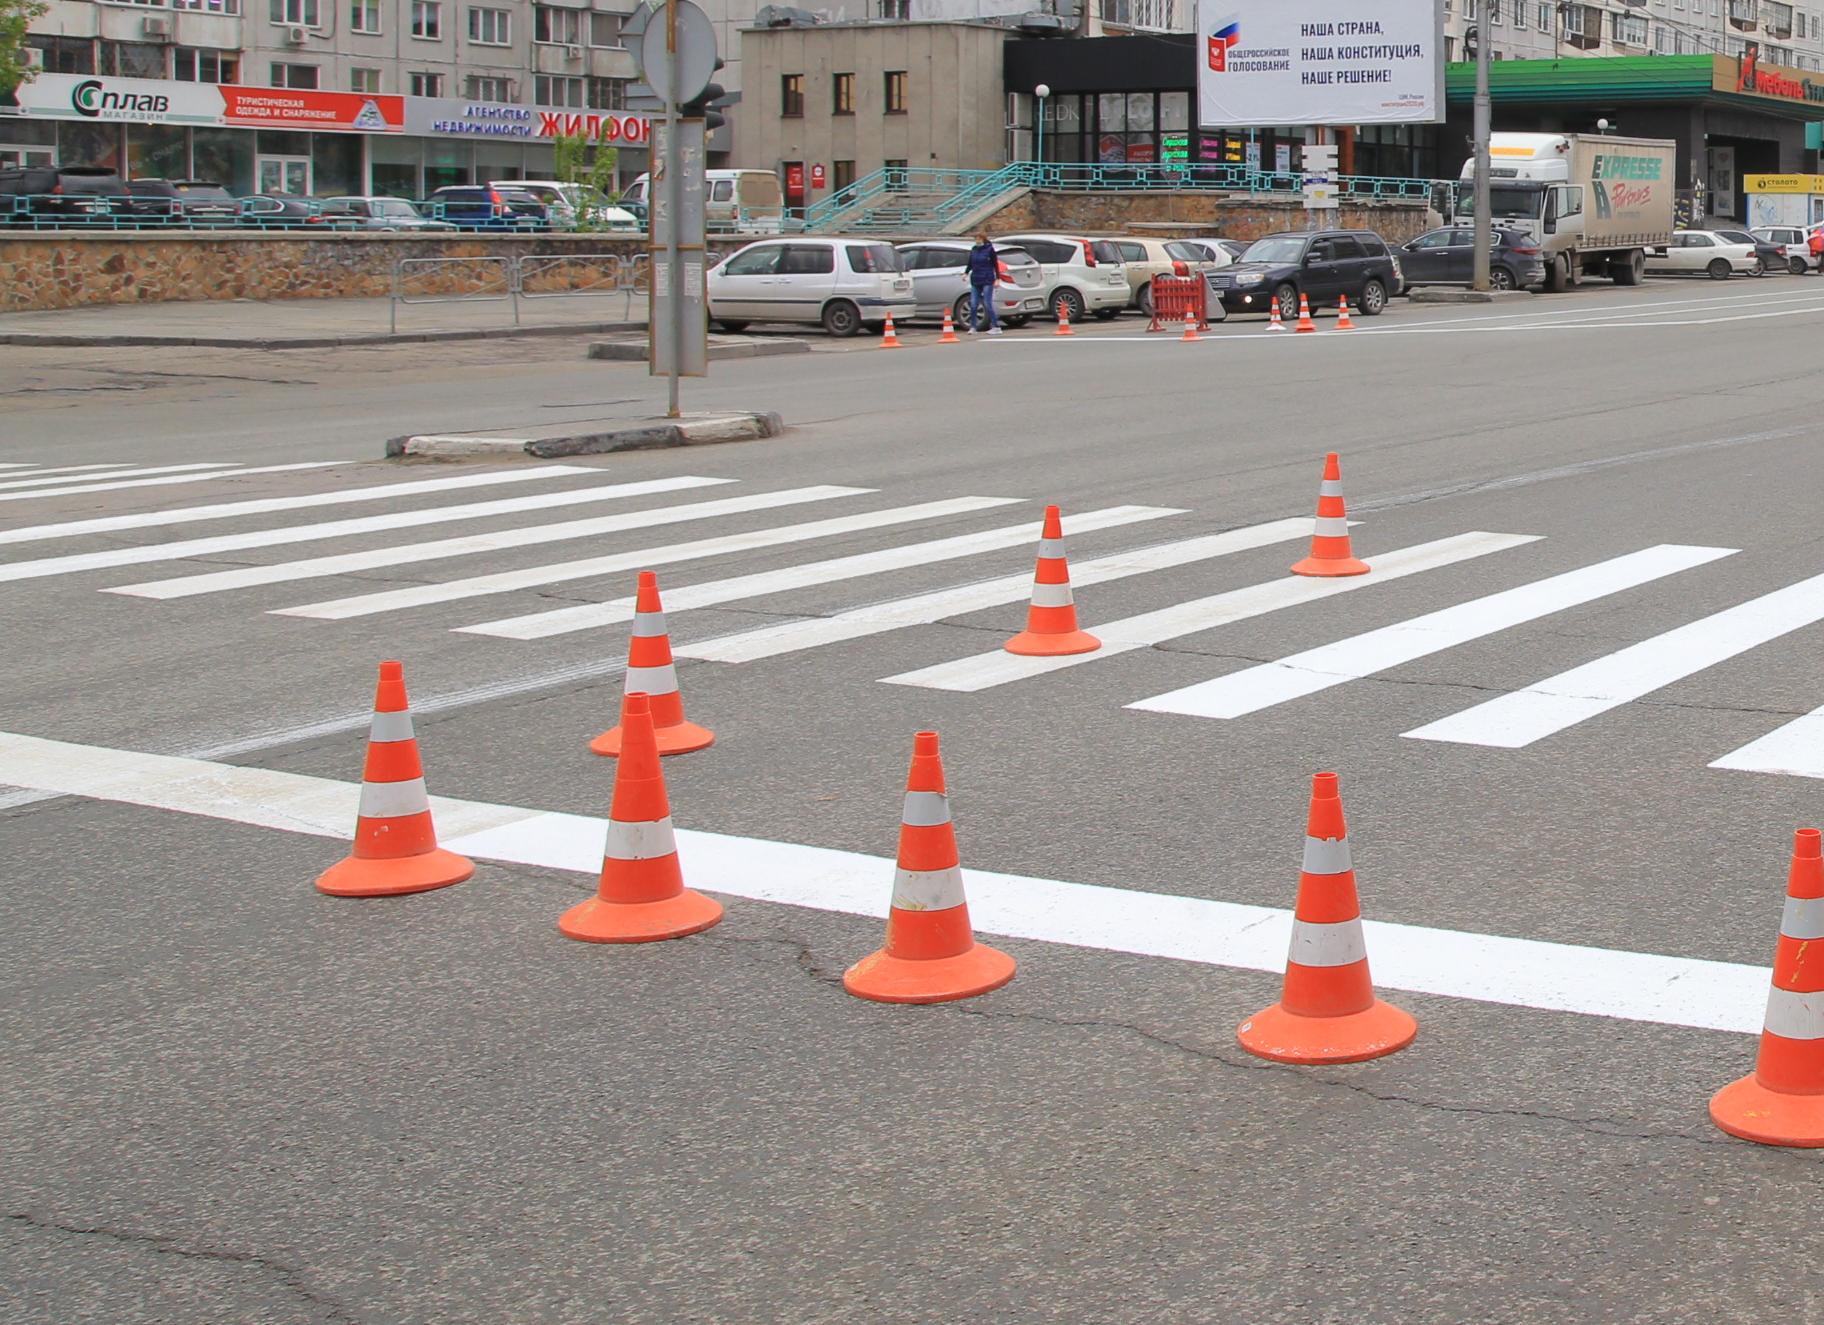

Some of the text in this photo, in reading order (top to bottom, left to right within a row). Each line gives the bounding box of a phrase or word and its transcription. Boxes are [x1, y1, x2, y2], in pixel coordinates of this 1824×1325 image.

[1301, 21, 1384, 37] НАША СТРАНА,
[1228, 48, 1290, 59] ОБЩЕРОССИЙСКОЕ
[1301, 43, 1424, 61] НАША КОНСТИТУЦИЯ,
[1228, 60, 1290, 73] ГОЛОСОВАНИЕ
[1301, 70, 1391, 85] НАШЕ РЕШЕНИЕ!
[72, 80, 169, 117] Сплав
[236, 96, 304, 107] ТУРИСТИЧЕСКАЯ
[103, 111, 164, 120] МАГАЗИН
[236, 106, 272, 117] ОДЕЖДА
[282, 109, 337, 119] СНАРЯЖЕНИЕ
[465, 106, 531, 121] АГЕНТСТВО
[432, 121, 532, 137] НЕДВИЖИМОСТИ
[538, 111, 650, 142] ЖИЛФОН
[1592, 155, 1663, 180] EXPRESSE
